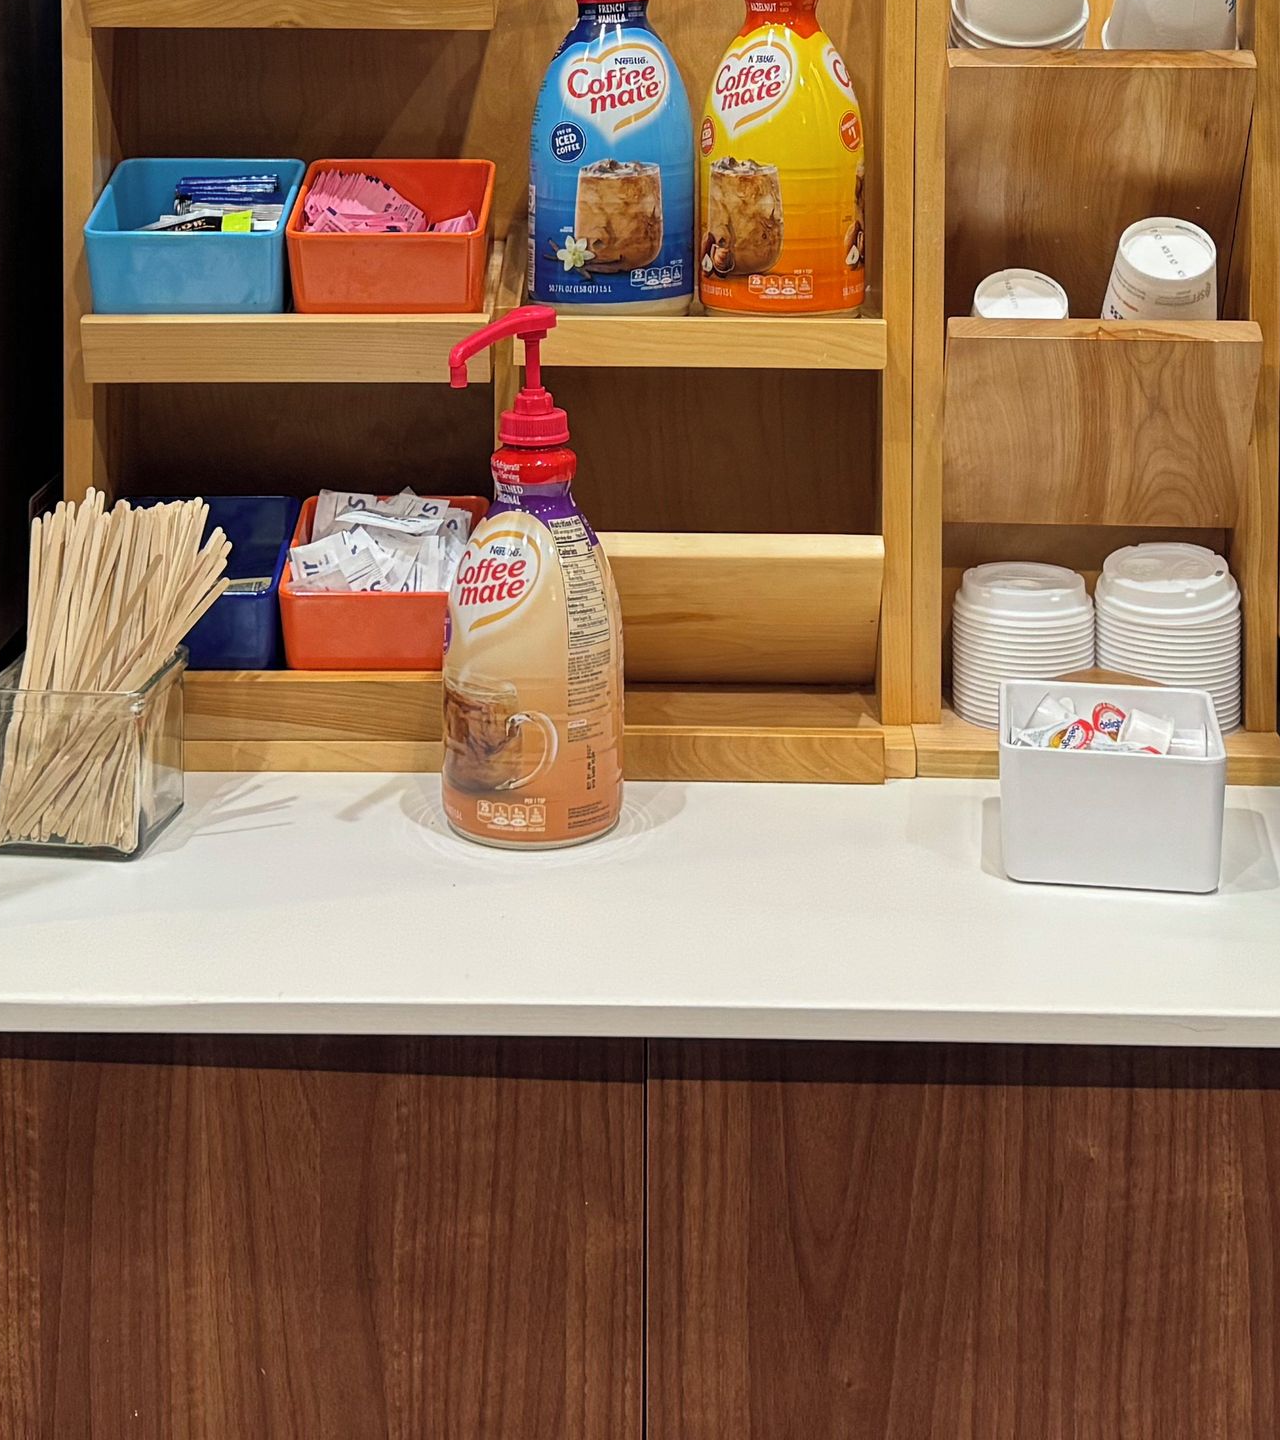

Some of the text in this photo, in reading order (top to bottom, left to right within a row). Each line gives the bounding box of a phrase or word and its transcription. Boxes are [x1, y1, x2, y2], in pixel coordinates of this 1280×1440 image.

[567, 65, 655, 99] Coffee
[715, 64, 781, 96] Coffee
[721, 80, 782, 111] mate
[590, 81, 659, 114] mate
[555, 133, 577, 147] ICED
[457, 550, 526, 585] Coffee
[459, 579, 525, 606] mate
